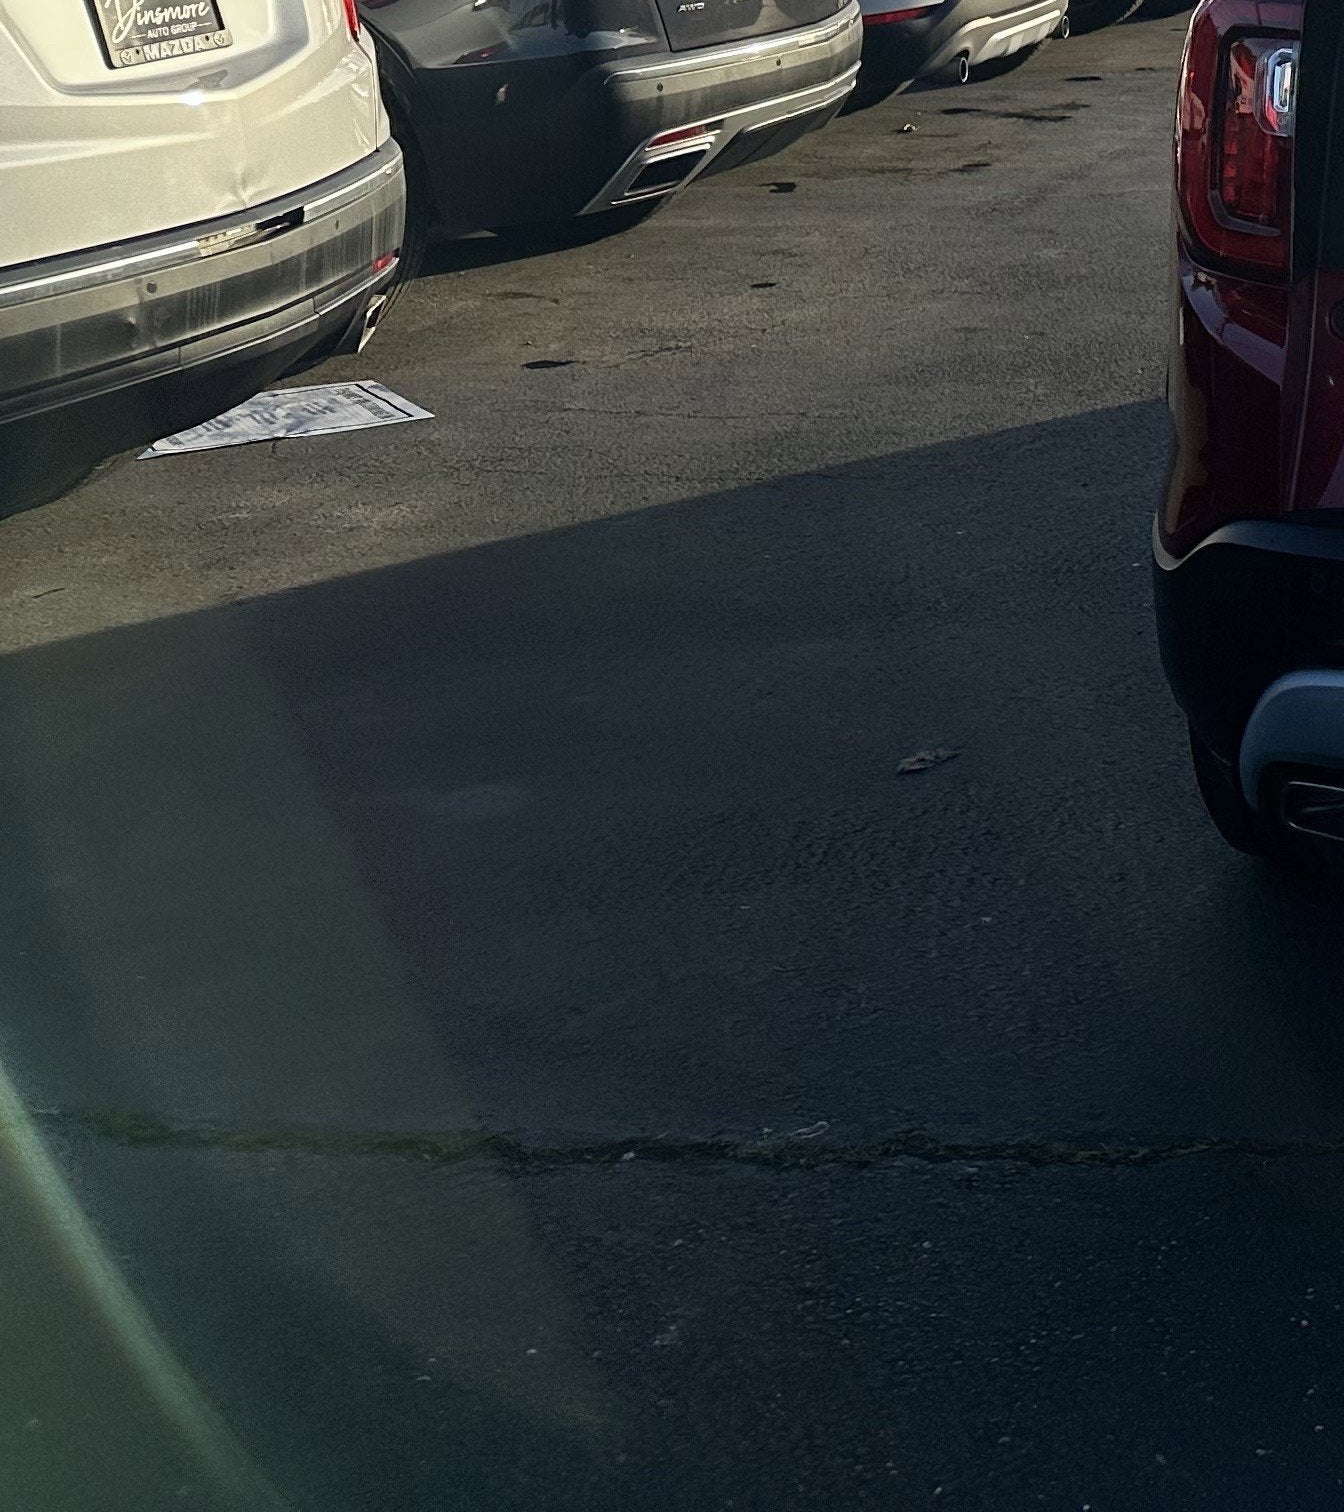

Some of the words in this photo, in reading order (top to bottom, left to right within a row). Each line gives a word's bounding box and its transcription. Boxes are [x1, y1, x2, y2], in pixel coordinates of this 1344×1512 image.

[147, 27, 169, 38] AUTO
[170, 21, 198, 36] GROUP
[142, 34, 204, 61] MAZDA
